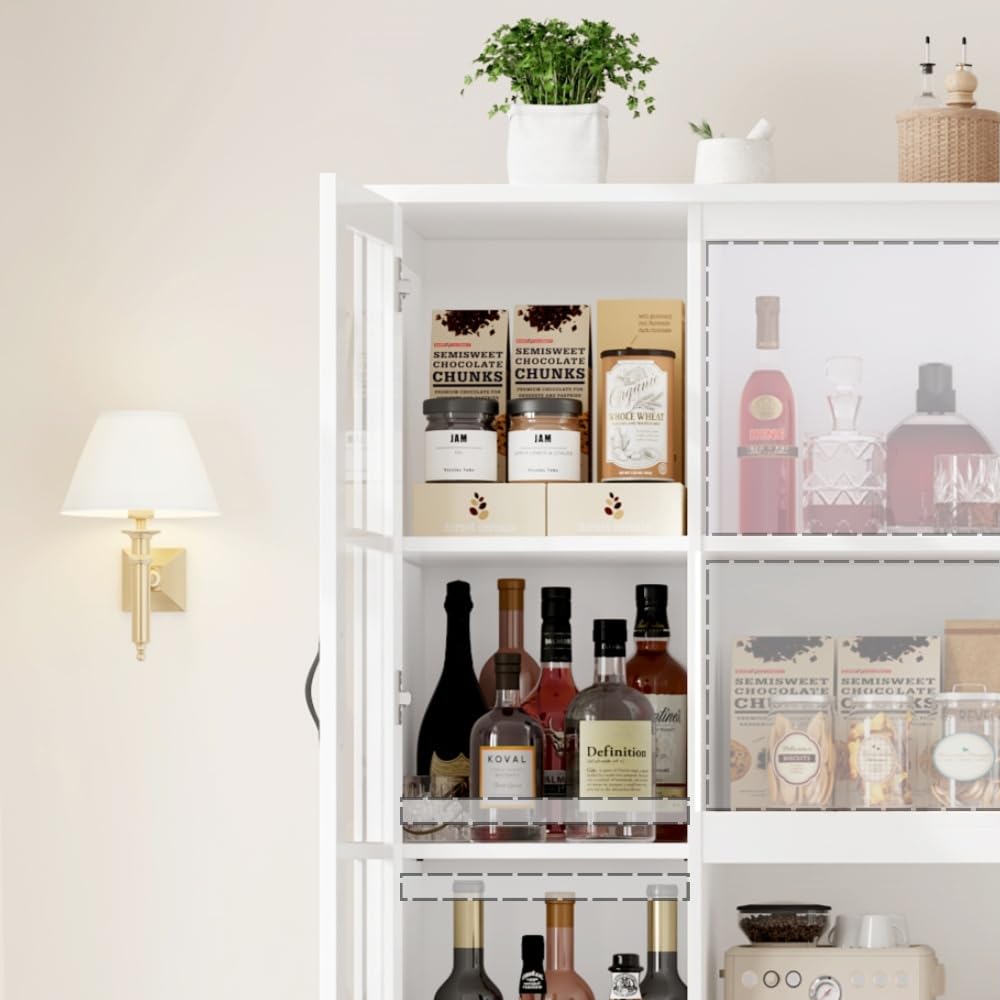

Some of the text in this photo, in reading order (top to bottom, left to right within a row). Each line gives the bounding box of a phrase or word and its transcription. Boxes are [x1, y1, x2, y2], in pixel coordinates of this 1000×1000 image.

[433, 351, 503, 359] SEMISWEET
[515, 347, 586, 355] SEMISWEET
[433, 360, 503, 368] CHOCOLATE
[515, 357, 585, 365] CHOCOLATE
[432, 371, 503, 383] CHUNKS
[515, 367, 585, 380] CHUNKS
[636, 412, 664, 421] WHEAT
[450, 434, 468, 443] JAM
[534, 434, 552, 443] JAM
[735, 677, 830, 686] SEMISWEET
[840, 677, 936, 685] SEMISWEET
[734, 687, 829, 695] CHOCOLATE
[840, 687, 937, 696] CHOCOLATE
[586, 744, 647, 758] Definition
[487, 755, 527, 764] KOVAL
